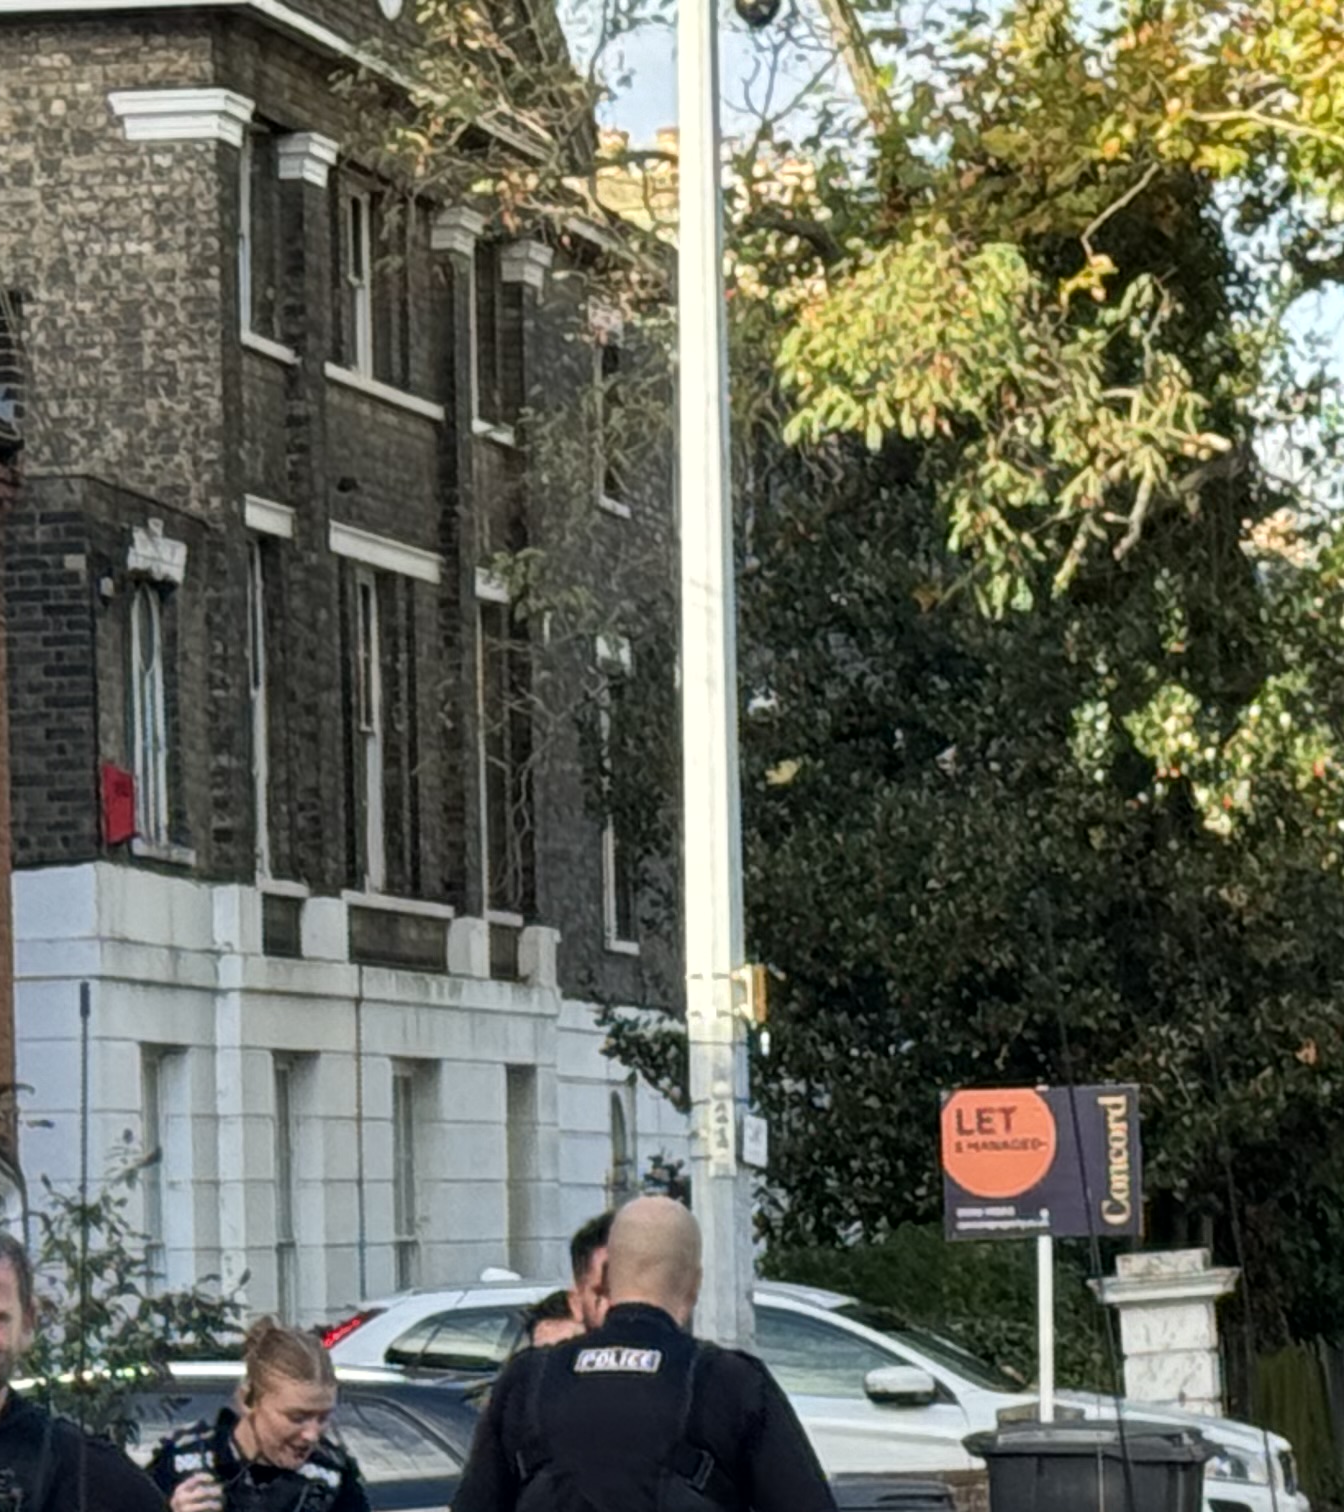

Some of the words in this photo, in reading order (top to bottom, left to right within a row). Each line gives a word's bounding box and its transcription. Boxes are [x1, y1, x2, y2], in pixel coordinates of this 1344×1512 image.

[956, 1106, 1017, 1136] LET
[1097, 1095, 1131, 1225] Concord
[577, 1351, 658, 1370] POLICE
